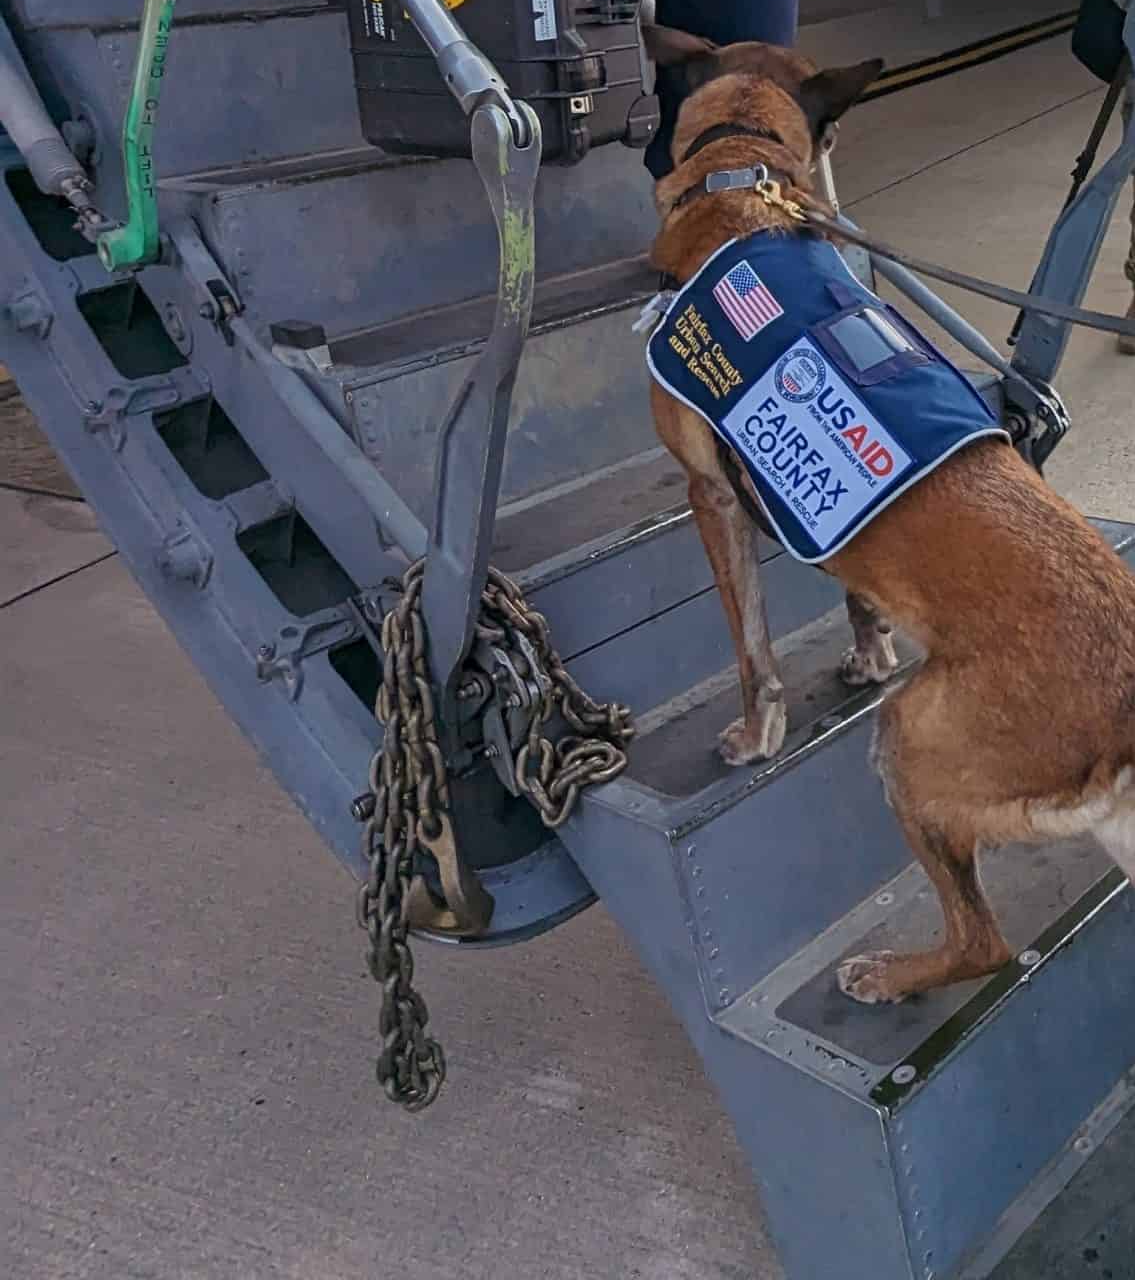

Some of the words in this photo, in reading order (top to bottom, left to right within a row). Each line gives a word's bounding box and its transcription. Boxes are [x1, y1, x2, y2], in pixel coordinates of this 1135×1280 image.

[143, 99, 159, 125] TO
[668, 335, 691, 359] and
[687, 355, 720, 399] Rescue
[675, 316, 700, 355] Urban
[700, 351, 731, 396] Search
[684, 303, 712, 345] Fairfax
[712, 344, 743, 386] County
[745, 415, 834, 517] COUNTY
[757, 397, 848, 505] FAIRFAX
[806, 404, 825, 426] FROM
[822, 422, 834, 436] THE
[830, 433, 858, 467] AMERICAN
[855, 461, 878, 489] PEOPLE
[817, 385, 893, 477] USAID
[736, 428, 758, 457] URBAN
[757, 456, 786, 489] SEARCH
[785, 488, 793, 497] &
[791, 497, 820, 530] RESCUE
